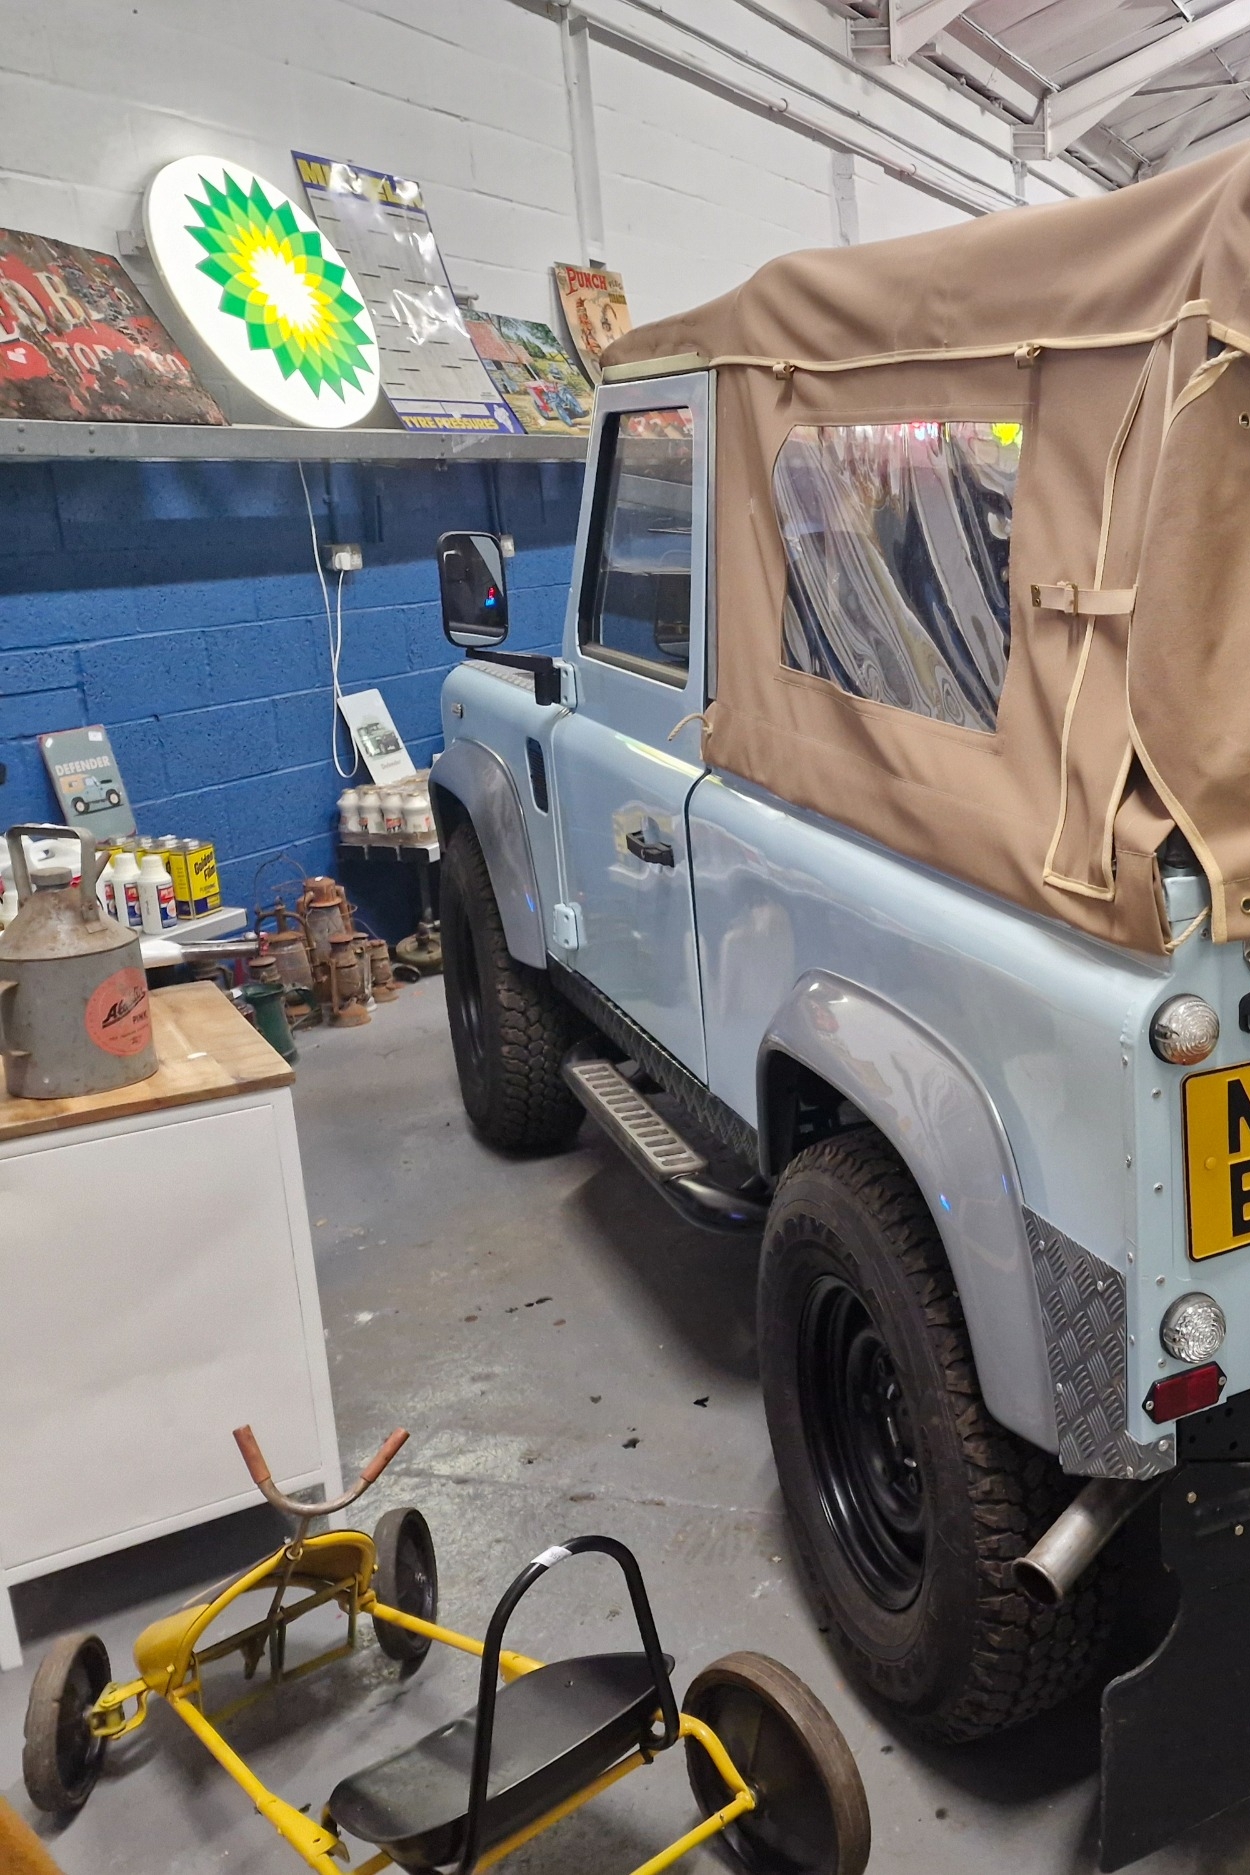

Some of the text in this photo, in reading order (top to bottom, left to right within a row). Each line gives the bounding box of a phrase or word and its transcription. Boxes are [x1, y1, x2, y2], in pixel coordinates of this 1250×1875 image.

[297, 158, 425, 211] MIEL
[565, 267, 608, 296] PUNCH
[51, 341, 191, 388] TOCO
[401, 416, 499, 430] TYRE PRESSURES
[55, 756, 110, 776] DEFENDER
[194, 851, 214, 876] Golden
[204, 865, 217, 882] Film
